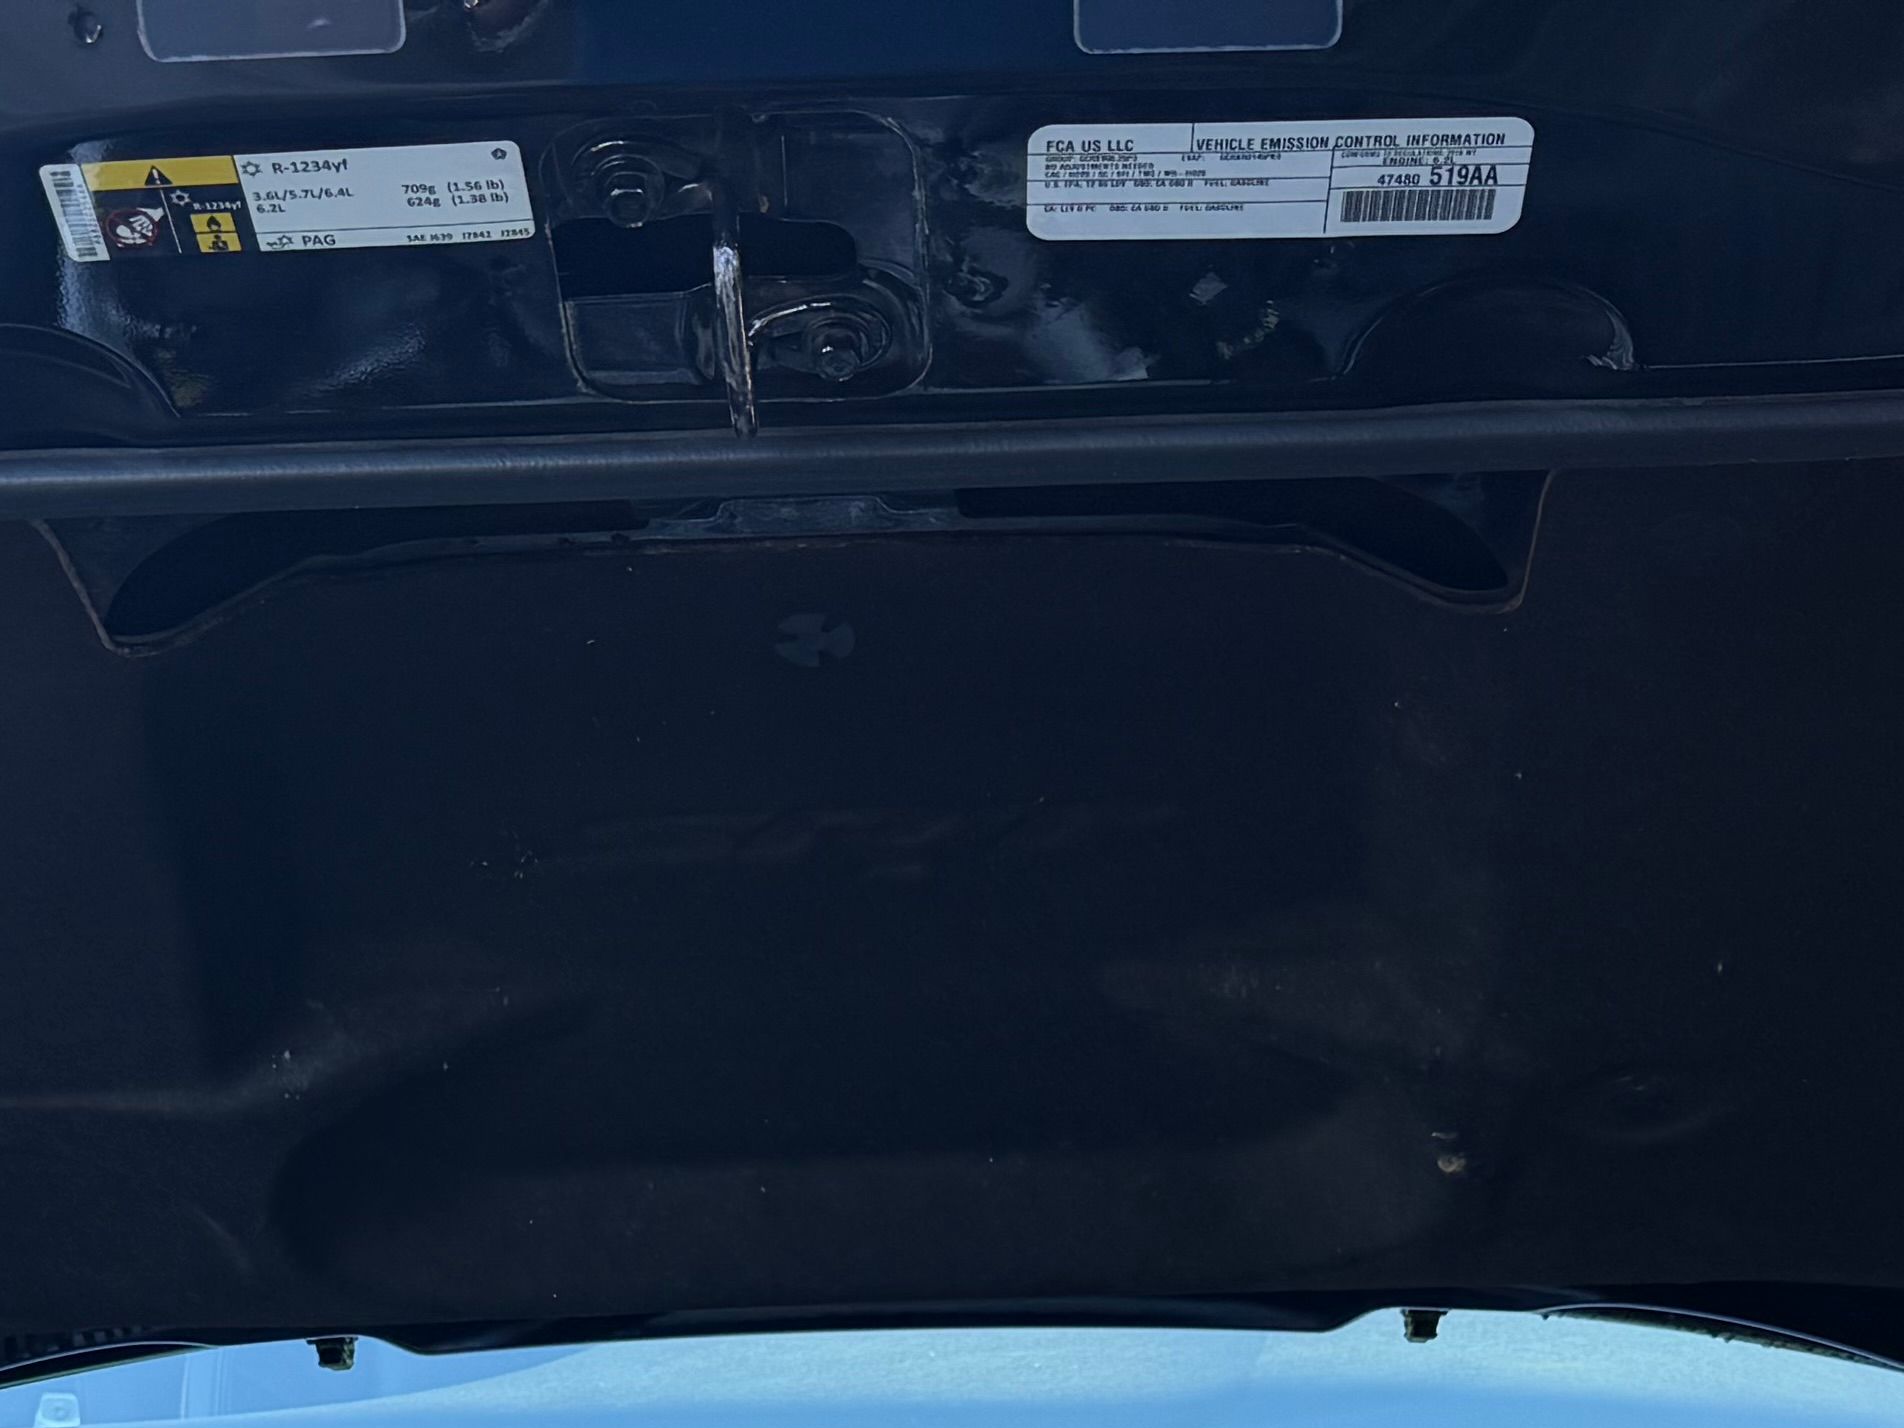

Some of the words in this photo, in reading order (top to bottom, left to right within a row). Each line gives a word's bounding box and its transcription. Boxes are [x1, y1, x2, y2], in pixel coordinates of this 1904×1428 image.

[1046, 139, 1075, 152] FCA
[1081, 139, 1102, 152] US
[1107, 139, 1134, 152] LLC
[1196, 137, 1255, 151] VEHICLE
[1260, 136, 1330, 150] EMISSION
[1335, 135, 1400, 148] CONTROL
[1406, 133, 1506, 147] INFORMATION
[271, 158, 349, 175] R-1234yf
[1377, 173, 1421, 186] 47480
[1429, 164, 1498, 186] 519AA
[252, 187, 355, 202] 3.6L/5.7L/6.4L
[401, 183, 437, 195] 709g
[447, 180, 483, 194] (1.56
[486, 178, 505, 192] lb)
[256, 203, 286, 214] 6.2L
[406, 196, 442, 208] 624g
[490, 191, 509, 205] lb)
[301, 234, 337, 247] PAG
